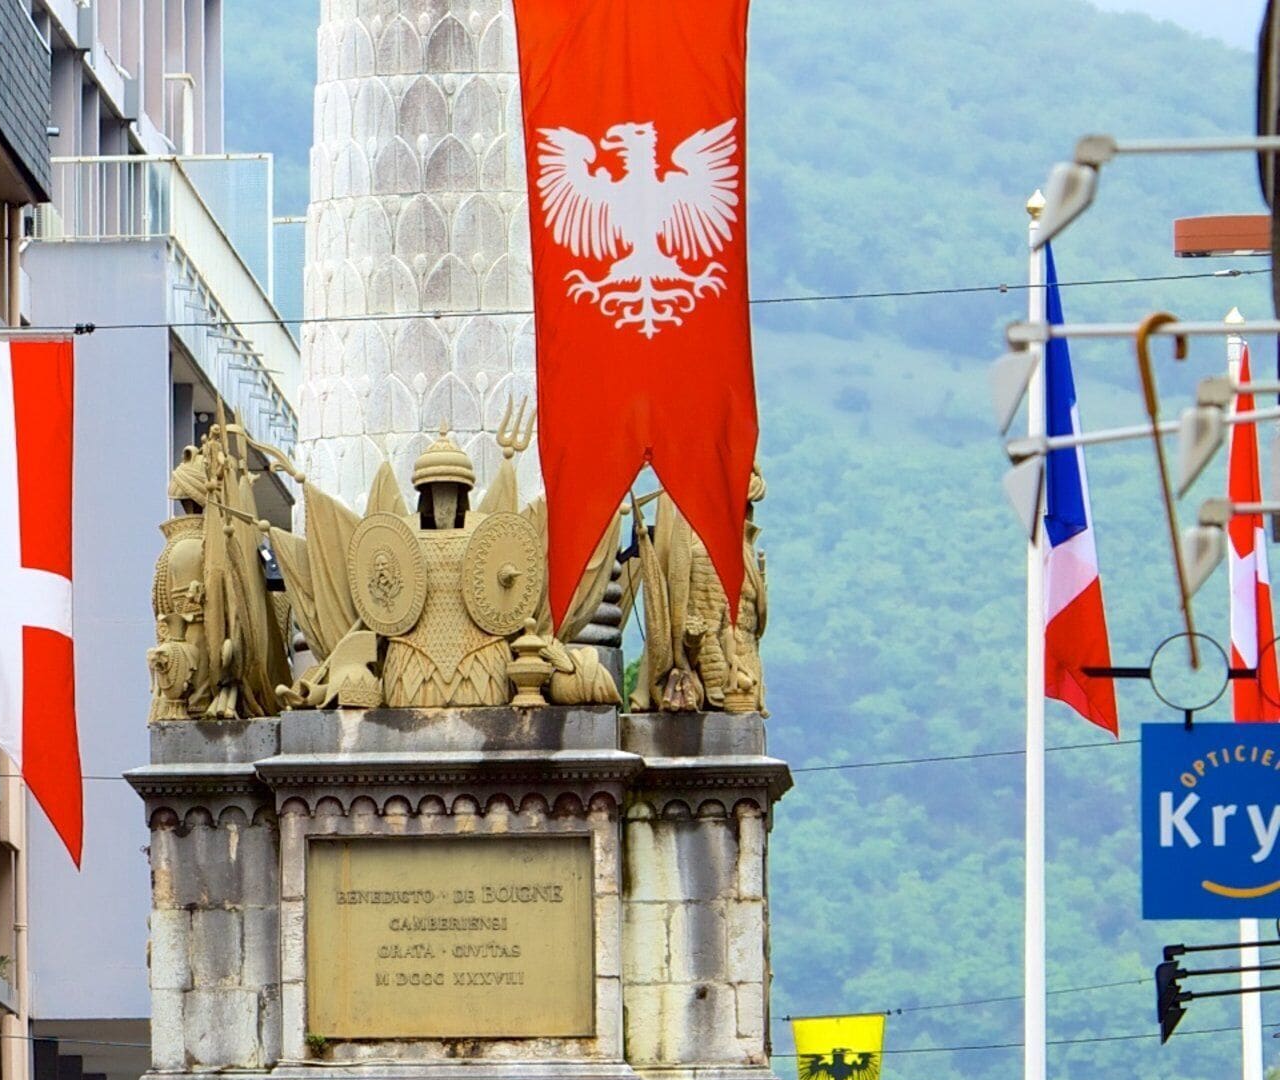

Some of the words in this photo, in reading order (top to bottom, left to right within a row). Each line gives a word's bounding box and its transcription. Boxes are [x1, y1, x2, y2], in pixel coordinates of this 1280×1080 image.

[336, 890, 435, 905] BENEDICTO
[452, 890, 476, 904] DE
[482, 884, 564, 904] BOIGNE
[389, 917, 508, 931] CAMBERIENSI
[377, 944, 436, 958] GRATA
[451, 944, 522, 958] CIVITAS
[375, 973, 390, 987] M
[396, 972, 444, 986] DCCC
